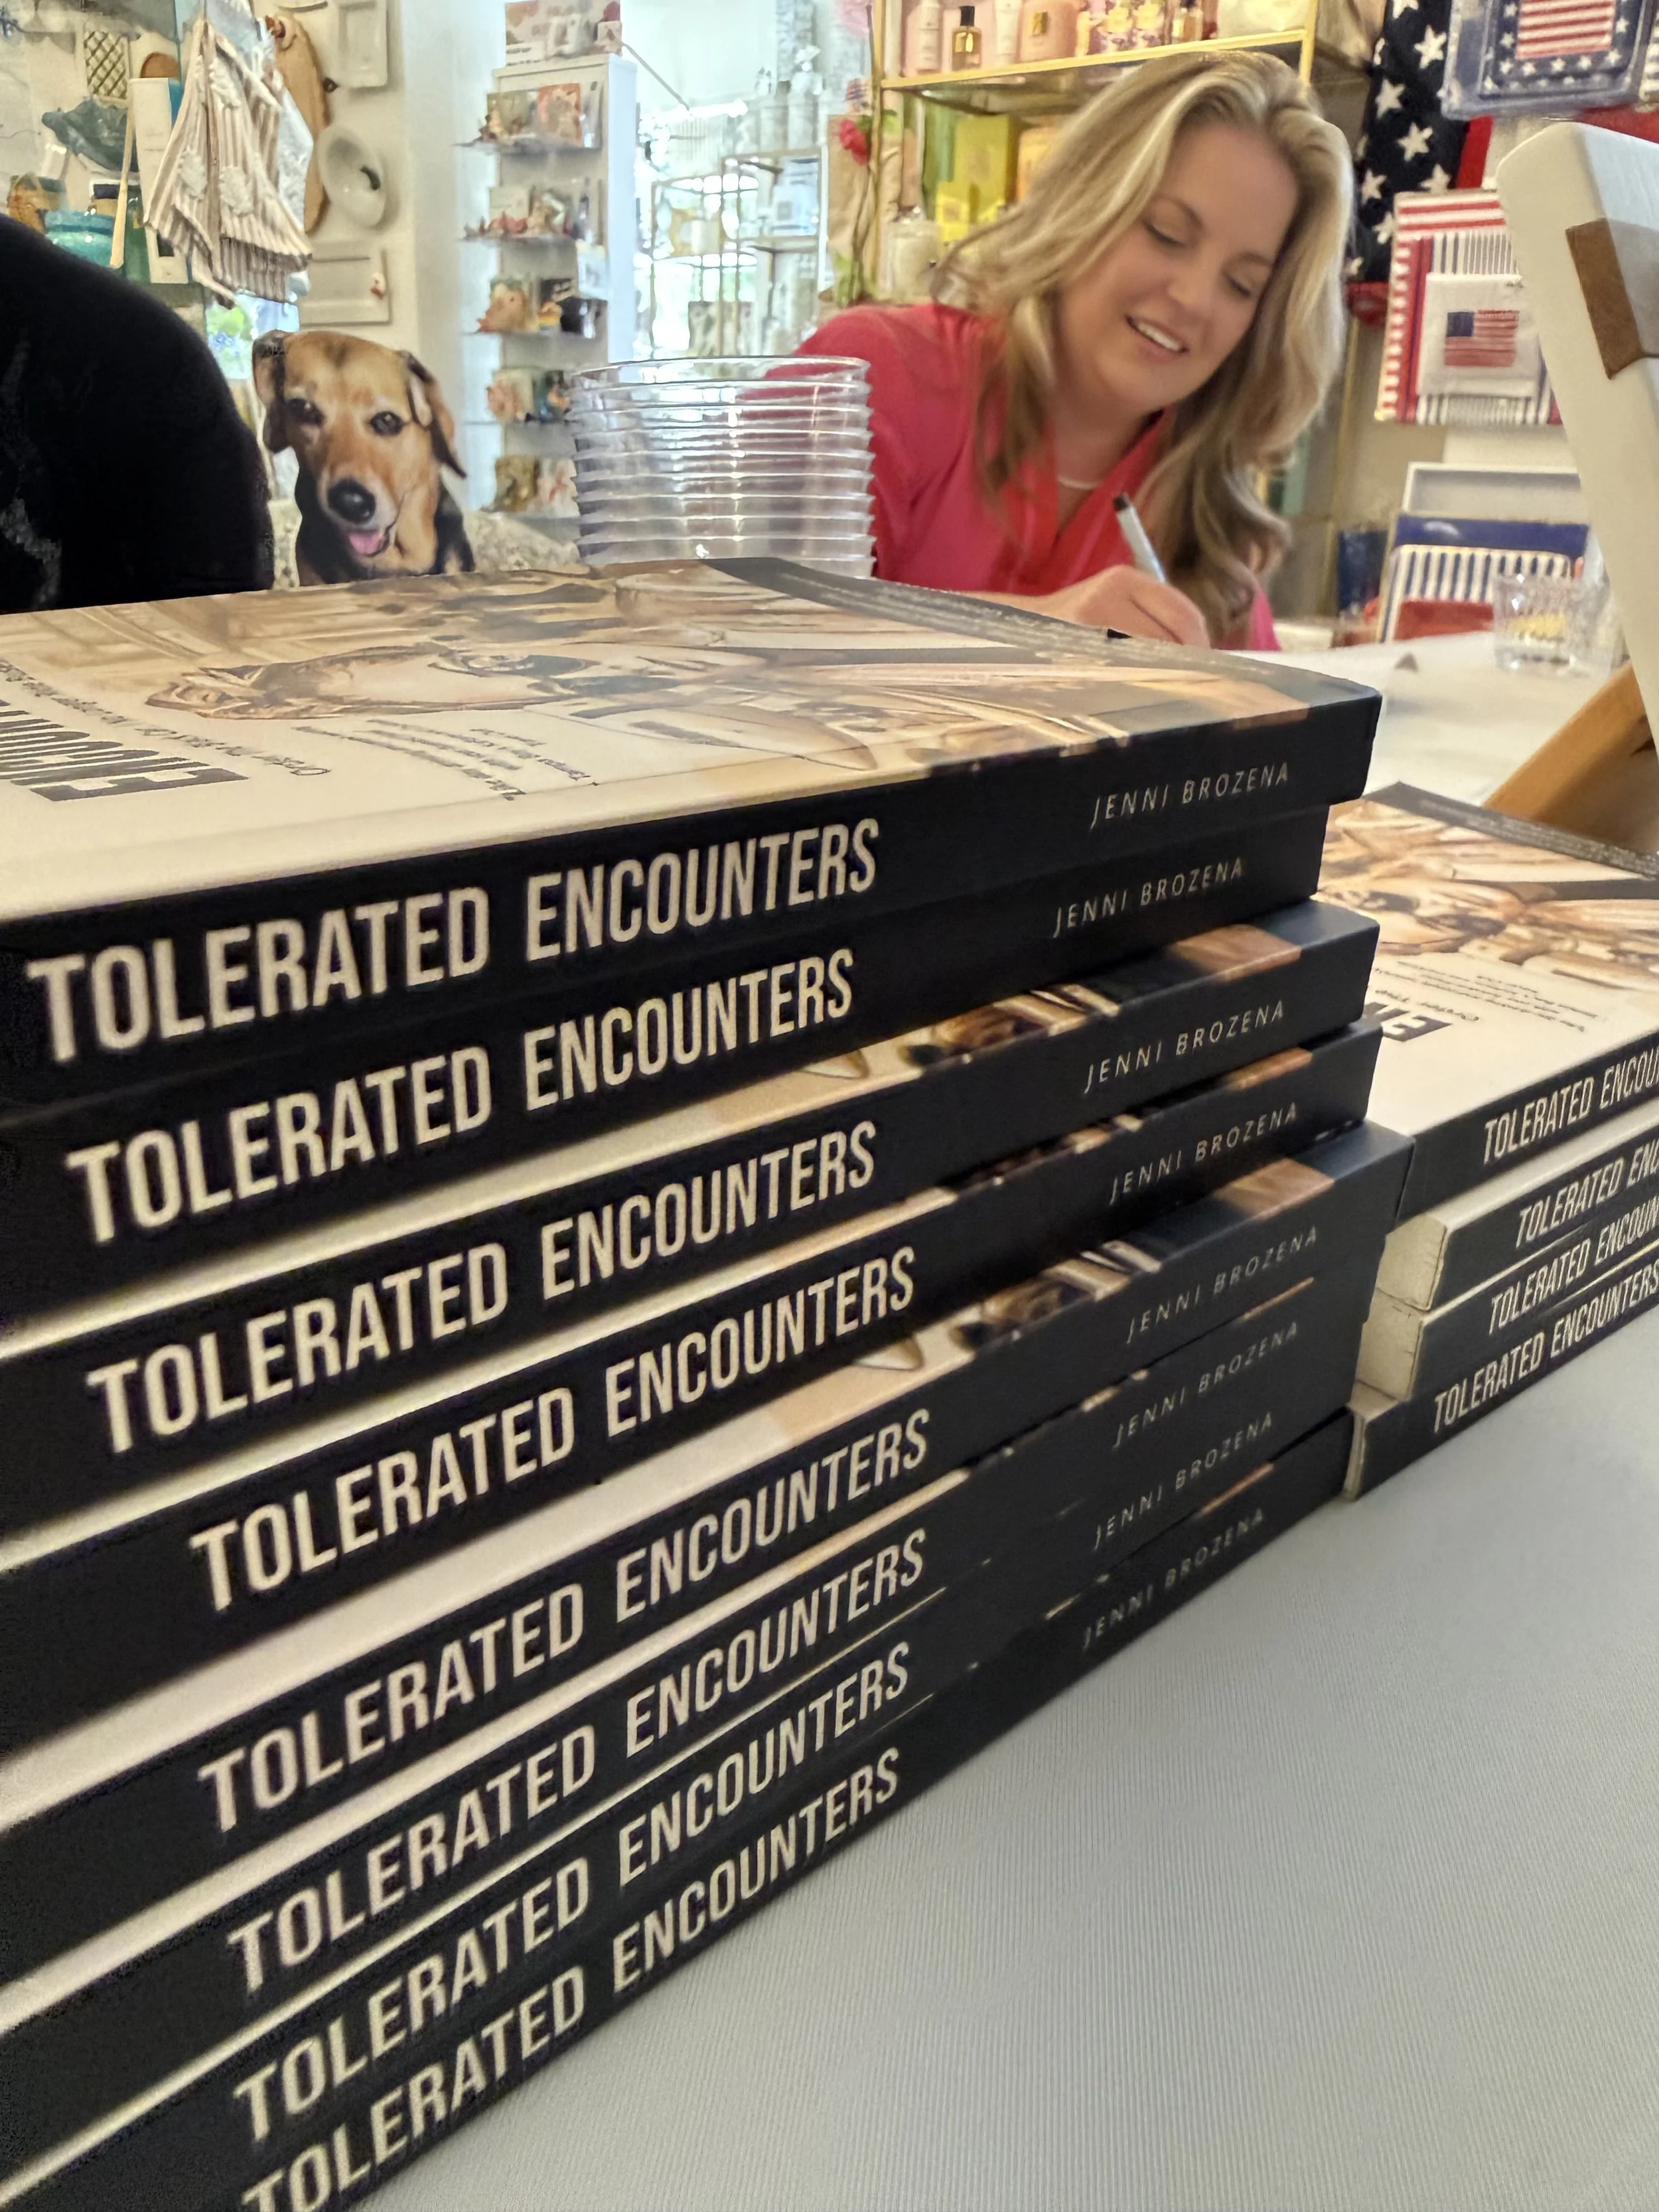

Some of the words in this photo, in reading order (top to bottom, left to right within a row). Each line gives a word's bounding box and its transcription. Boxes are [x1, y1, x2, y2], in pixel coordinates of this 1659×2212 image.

[1090, 783, 1169, 831] JENNI
[1182, 761, 1288, 804] BROZENA
[25, 886, 490, 1064] TOLERATED
[526, 818, 879, 962] ENCOUNTERS
[1053, 891, 1127, 938] JENNI
[1140, 857, 1244, 906] BROZENA
[65, 1047, 492, 1245] TOLERATED
[524, 948, 853, 1111] ENCOUNTERS
[1084, 1042, 1163, 1094] JENNI
[1176, 999, 1284, 1056] BROZENA
[1110, 1150, 1183, 1205] JENNI
[1195, 1102, 1297, 1162] BROZENA
[1483, 1076, 1594, 1164] TOLERATED
[1516, 1157, 1624, 1248] TOLERATED
[86, 1242, 508, 1453] TOLERATED
[541, 1120, 875, 1299] ENCOUNTERS
[1127, 1284, 1200, 1343] JENNI
[1213, 1225, 1318, 1294] BROZENA
[1434, 1331, 1545, 1433] TOLERATED
[1550, 1258, 1659, 1359] ENCOUNTERS
[1489, 1238, 1591, 1335] TOLERATED
[190, 1388, 575, 1612] TOLERATED
[605, 1246, 915, 1438] ENCOUNTERS
[1113, 1388, 1186, 1449] JENNI
[1198, 1321, 1299, 1394] BROZENA
[1094, 1485, 1163, 1551] JENNI
[1175, 1412, 1273, 1491] BROZENA
[198, 1584, 584, 1832] TOLERATED
[616, 1408, 930, 1623] ENCOUNTERS
[1083, 1584, 1154, 1653] JENNI
[1165, 1509, 1264, 1587] BROZENA
[227, 1726, 595, 1993] TOLERATED
[626, 1528, 926, 1758] ENCOUNTERS
[234, 1858, 589, 2142] TOLERATED
[620, 1642, 909, 1887] ENCOUNTERS
[242, 1965, 585, 2212] TOLERATED
[613, 1747, 900, 1992] ENCOUNTERS
